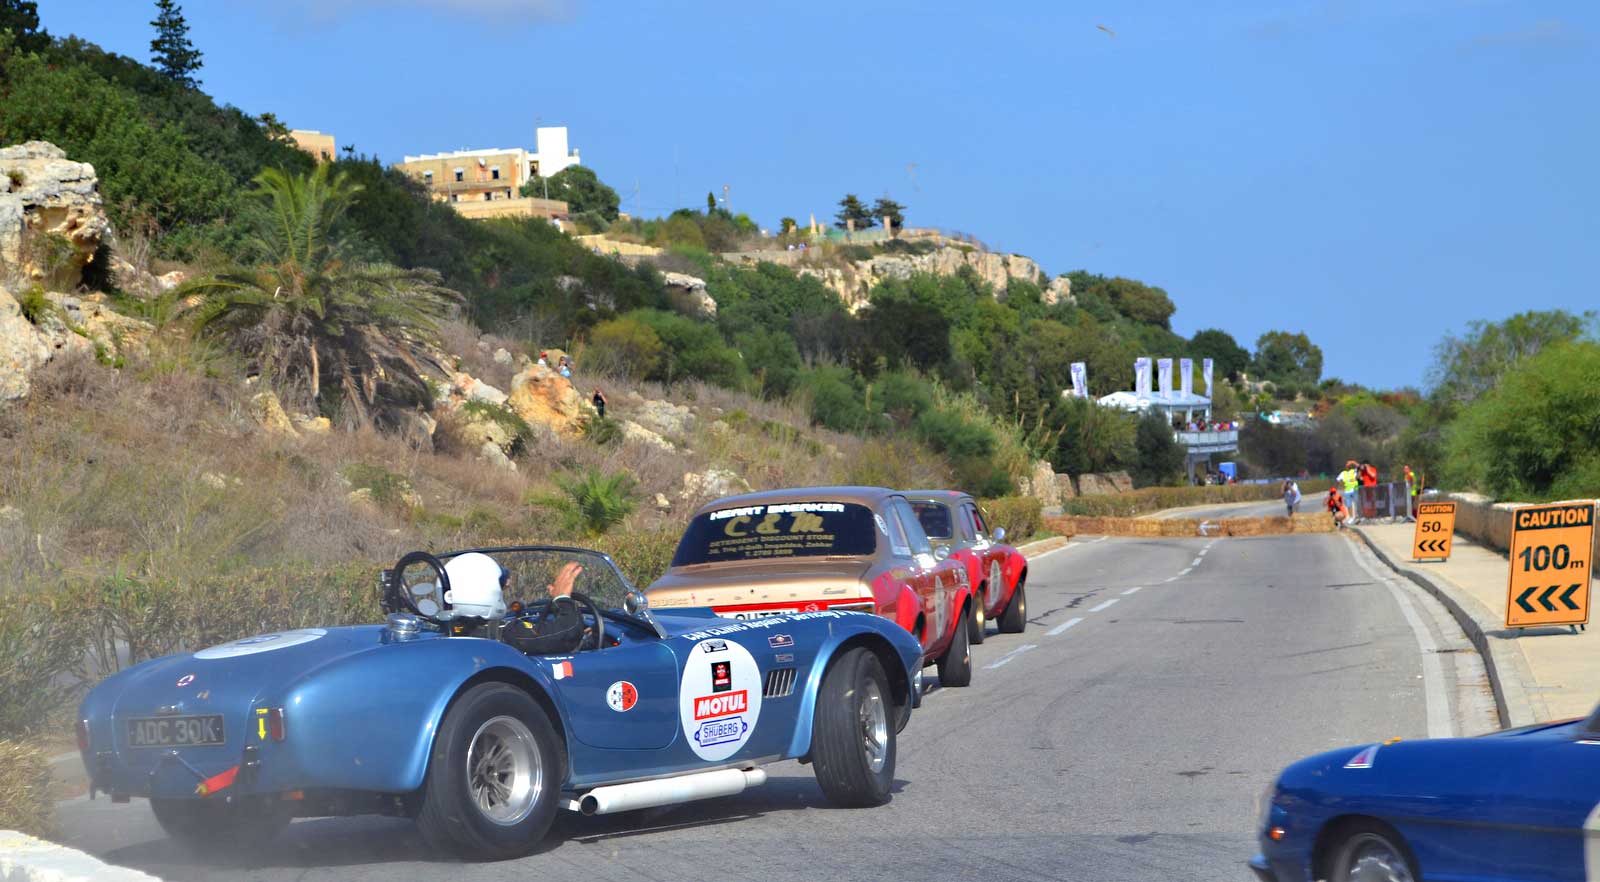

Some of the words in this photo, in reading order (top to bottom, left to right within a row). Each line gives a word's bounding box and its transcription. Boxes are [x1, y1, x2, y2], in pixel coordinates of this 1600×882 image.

[710, 506, 765, 520] HEART
[767, 503, 844, 513] BREAKER
[1421, 504, 1453, 513] CAUTION
[1519, 508, 1589, 528] CAUTION
[724, 515, 751, 537] C
[755, 513, 781, 535] &
[1518, 544, 1584, 572] 100m
[697, 694, 746, 717] MOTUL
[136, 720, 169, 744] ADC
[175, 718, 217, 742] 30K
